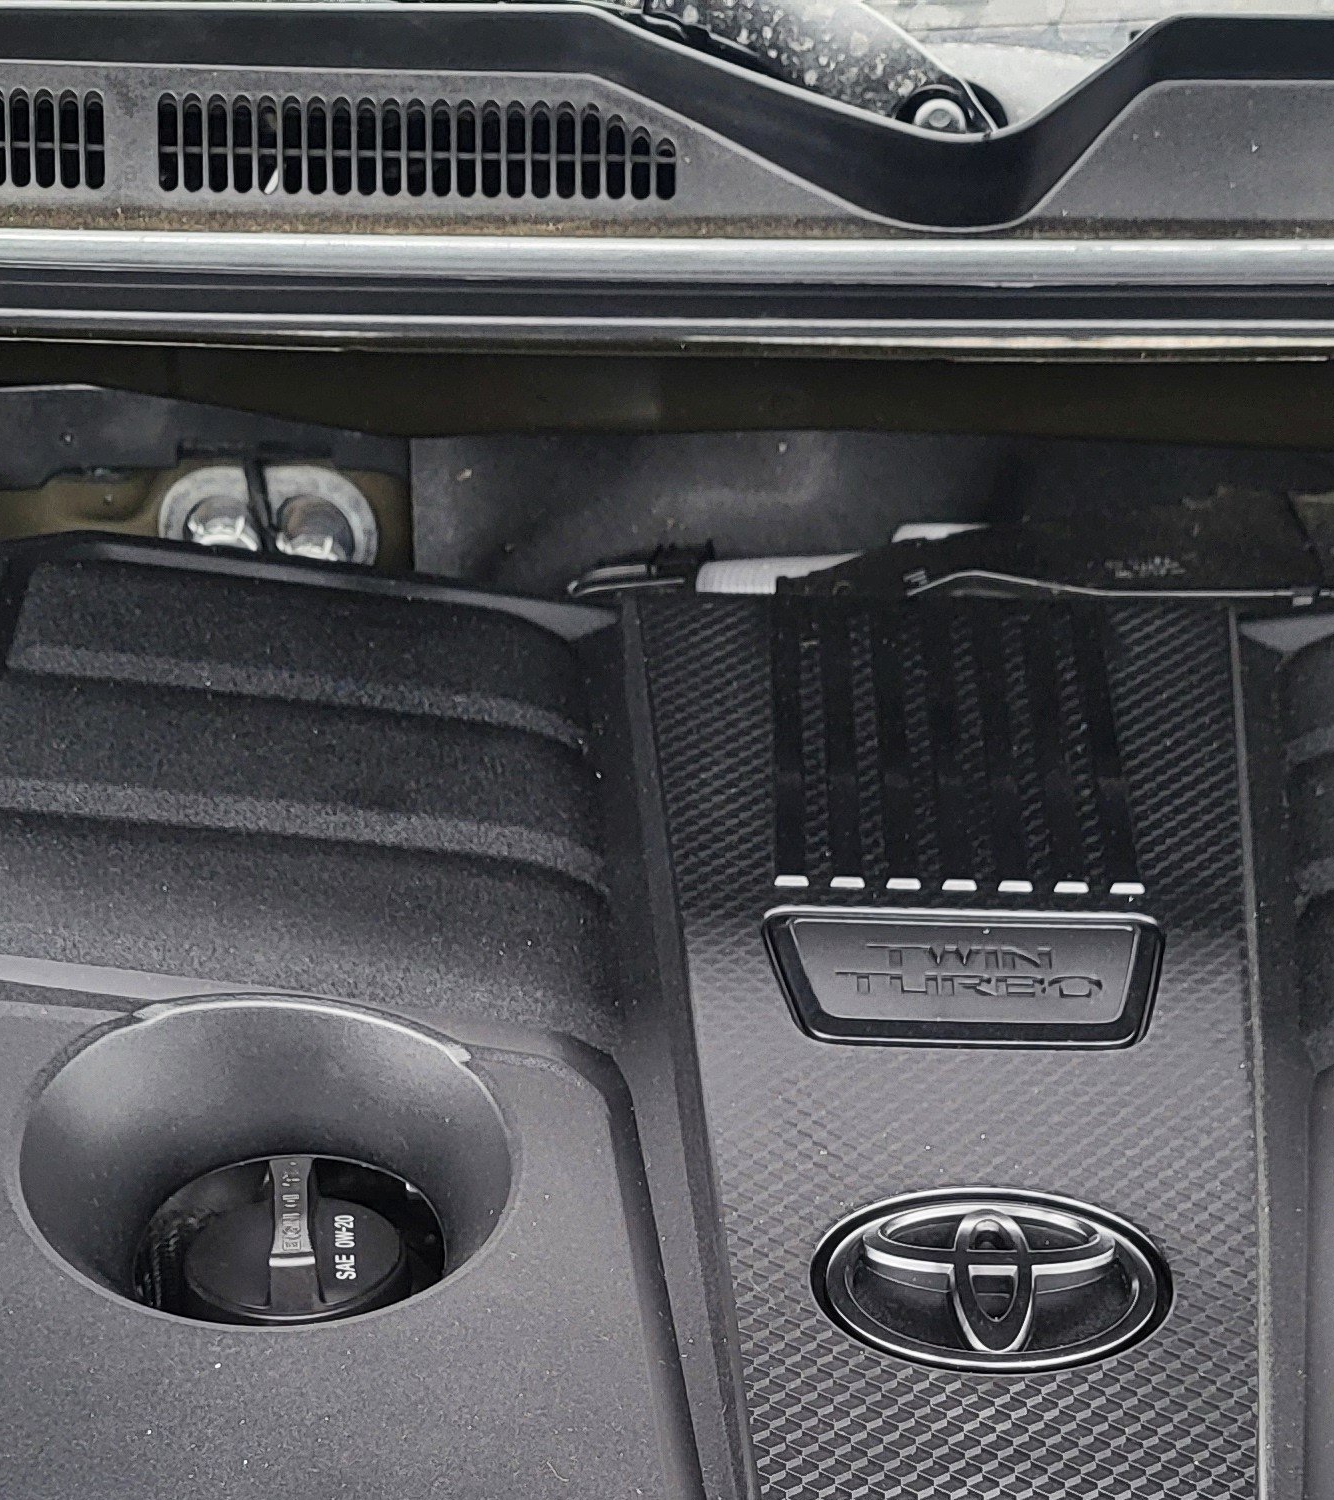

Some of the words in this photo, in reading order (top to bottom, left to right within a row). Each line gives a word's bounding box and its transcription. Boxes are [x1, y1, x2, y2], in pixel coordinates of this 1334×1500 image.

[865, 943, 1053, 970] TWIN
[834, 971, 1103, 998] TURBO
[334, 1214, 355, 1248] 0W-20
[334, 1254, 357, 1280] SAE
